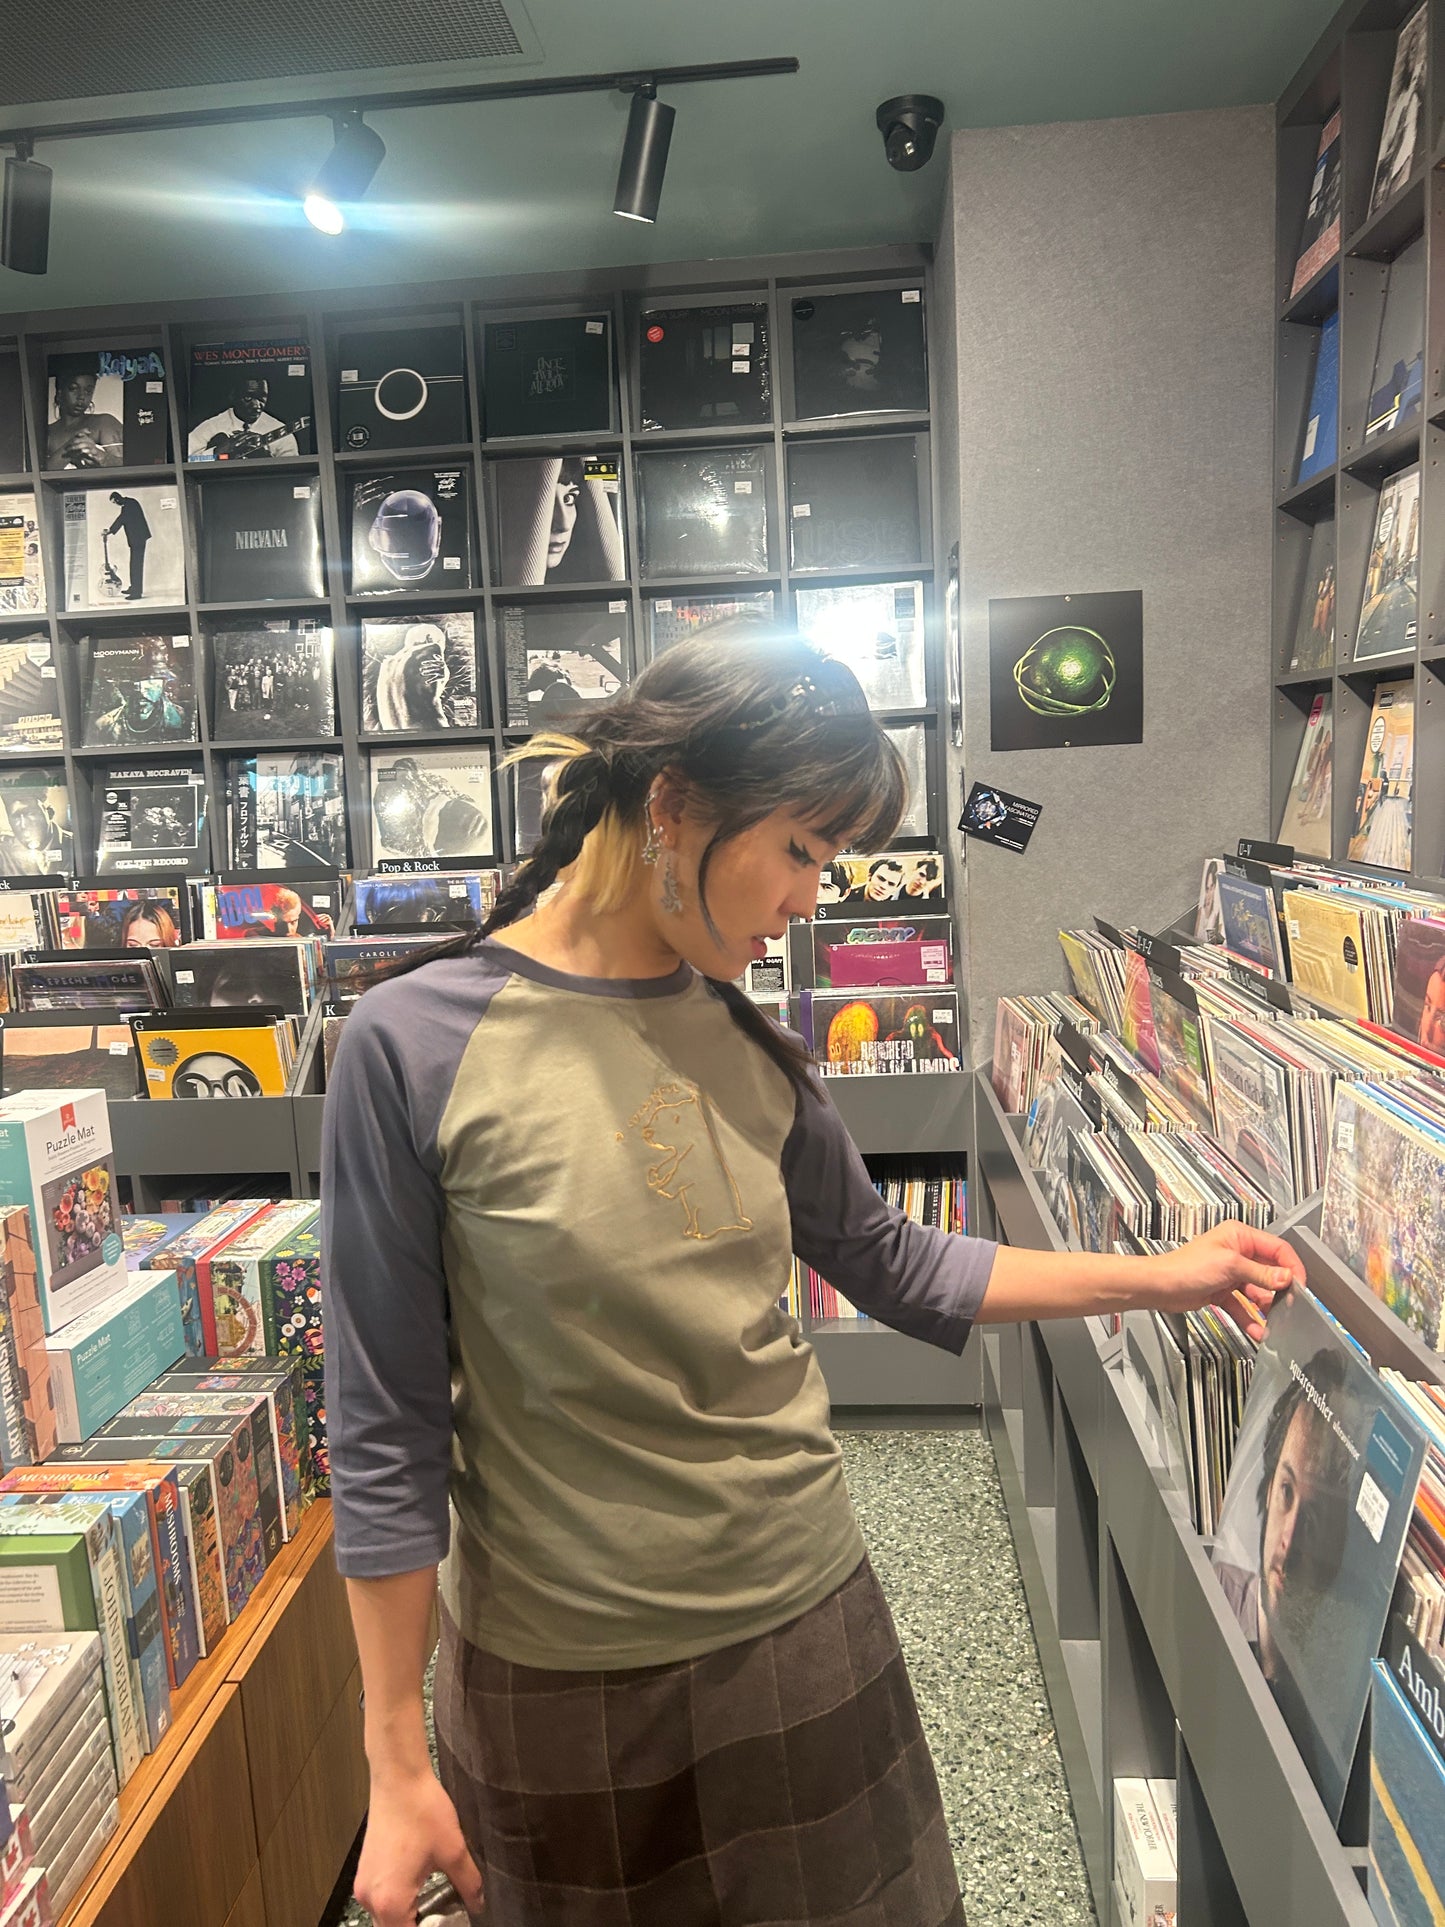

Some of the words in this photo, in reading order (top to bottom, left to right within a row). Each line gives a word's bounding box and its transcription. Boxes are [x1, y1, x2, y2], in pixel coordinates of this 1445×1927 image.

[194, 351, 218, 360] WES
[222, 345, 308, 359] MONTGOMERY
[235, 529, 288, 550] NIRVANA
[147, 769, 193, 777] MCCRAVEN
[1004, 805, 1036, 821] FASCINATION
[1012, 801, 1039, 815] MIRRORED
[153, 858, 189, 866] RECORD
[381, 862, 401, 874] Pop
[403, 861, 412, 871] &
[414, 860, 440, 871] Rock
[73, 880, 80, 890] F
[218, 875, 223, 885] I
[219, 886, 263, 928] IDOL
[819, 907, 826, 918] S
[847, 927, 916, 943] ROMY
[28, 954, 38, 963] E
[325, 1005, 335, 1016] K
[134, 1020, 144, 1031] G
[860, 1040, 914, 1061] RADIOHEAD
[46, 1133, 76, 1154] Puzzle
[77, 1126, 95, 1141] Mat
[77, 1344, 98, 1365] Puzzle
[97, 1334, 112, 1347] Mat
[1289, 1359, 1333, 1423] squarepusher
[5, 1404, 16, 1427] IN
[8, 1427, 22, 1459] ART
[17, 1473, 111, 1482] MUSHROOMS
[164, 1492, 181, 1586] MUSHROOMS
[103, 1576, 120, 1639] JOHN
[113, 1649, 132, 1738] DERIAN
[1144, 1828, 1158, 1851] YORKER
